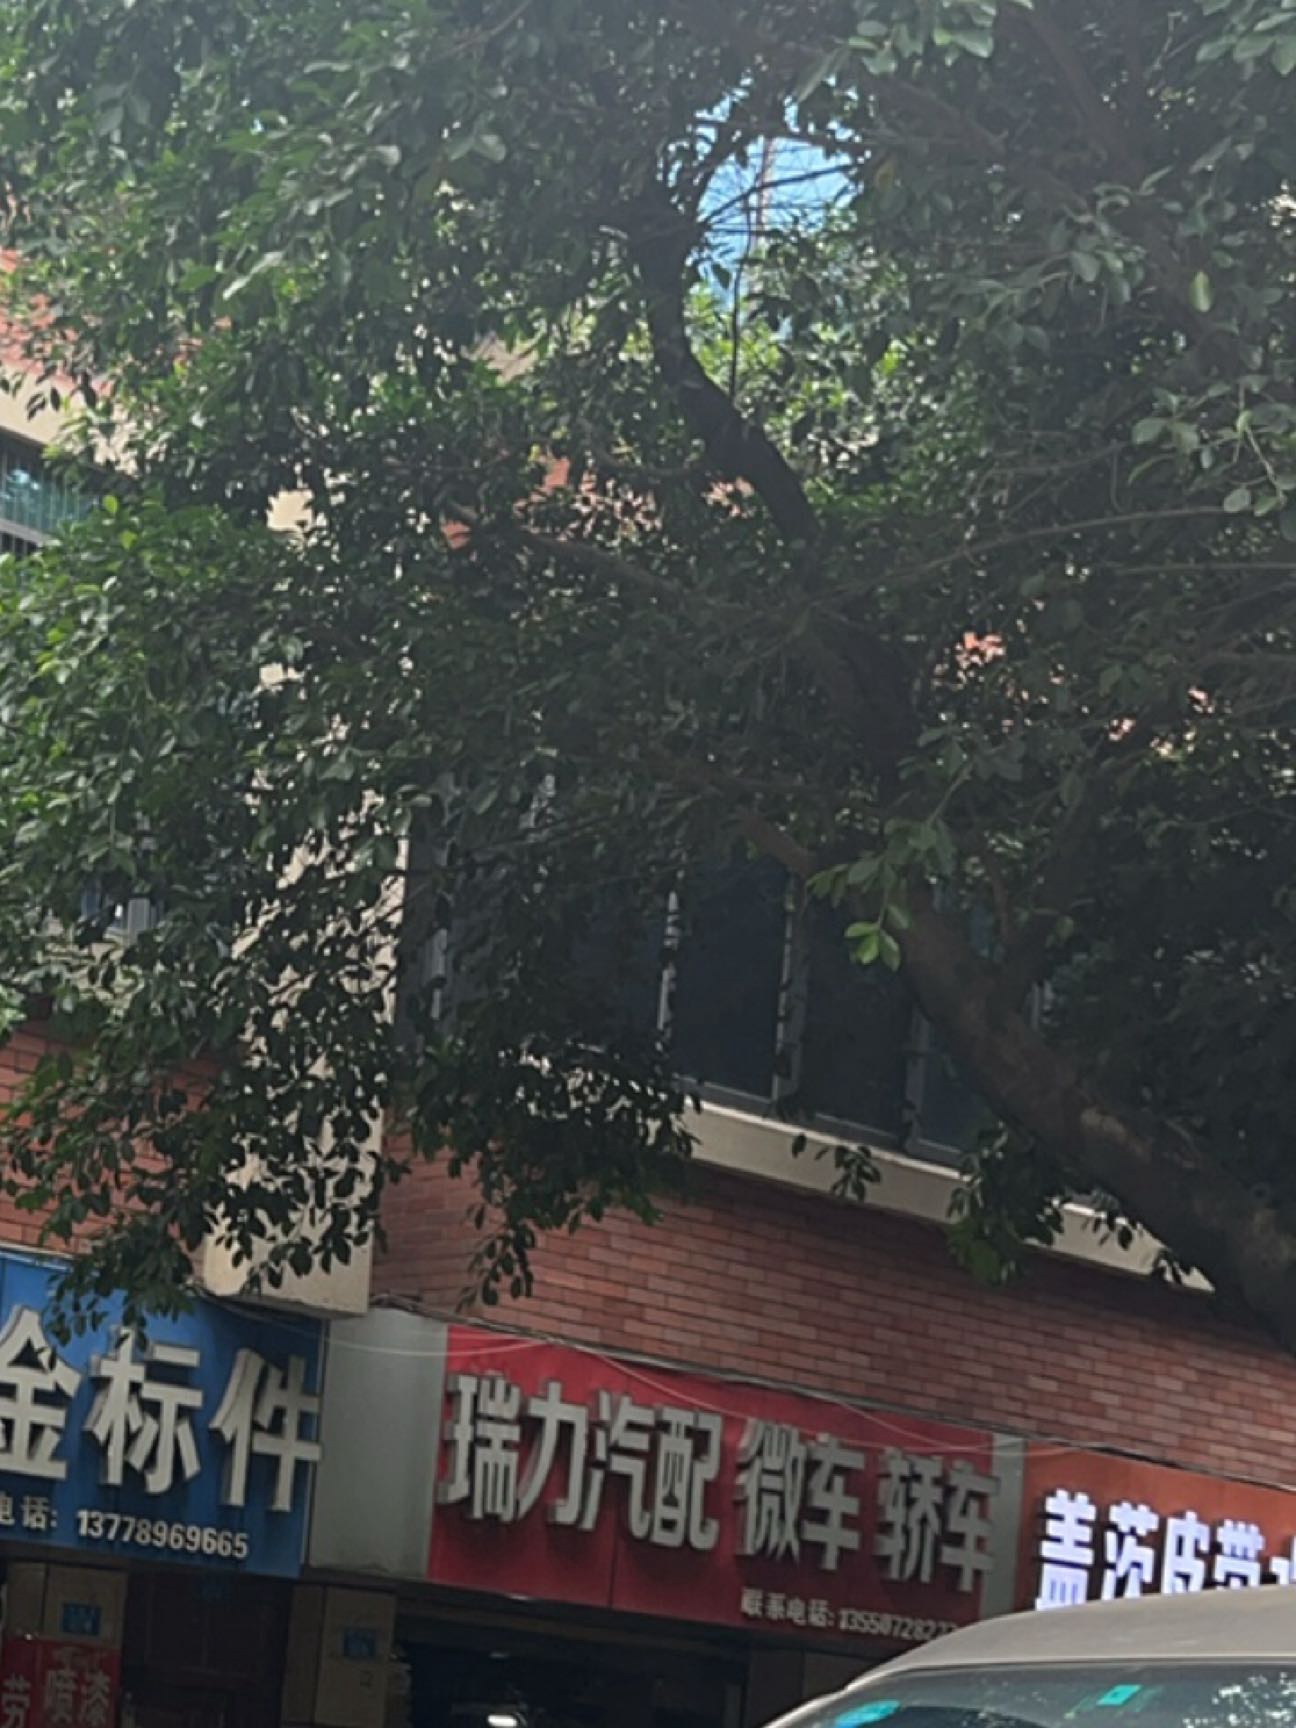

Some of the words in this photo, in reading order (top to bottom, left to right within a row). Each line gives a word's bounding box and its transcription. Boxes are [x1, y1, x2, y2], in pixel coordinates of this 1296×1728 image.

[436, 1370, 722, 1552] 瑞力汽配
[732, 1416, 867, 1571] 微车
[876, 1445, 1001, 1595] 轿车
[1035, 1488, 1296, 1612] 盖茨皮带
